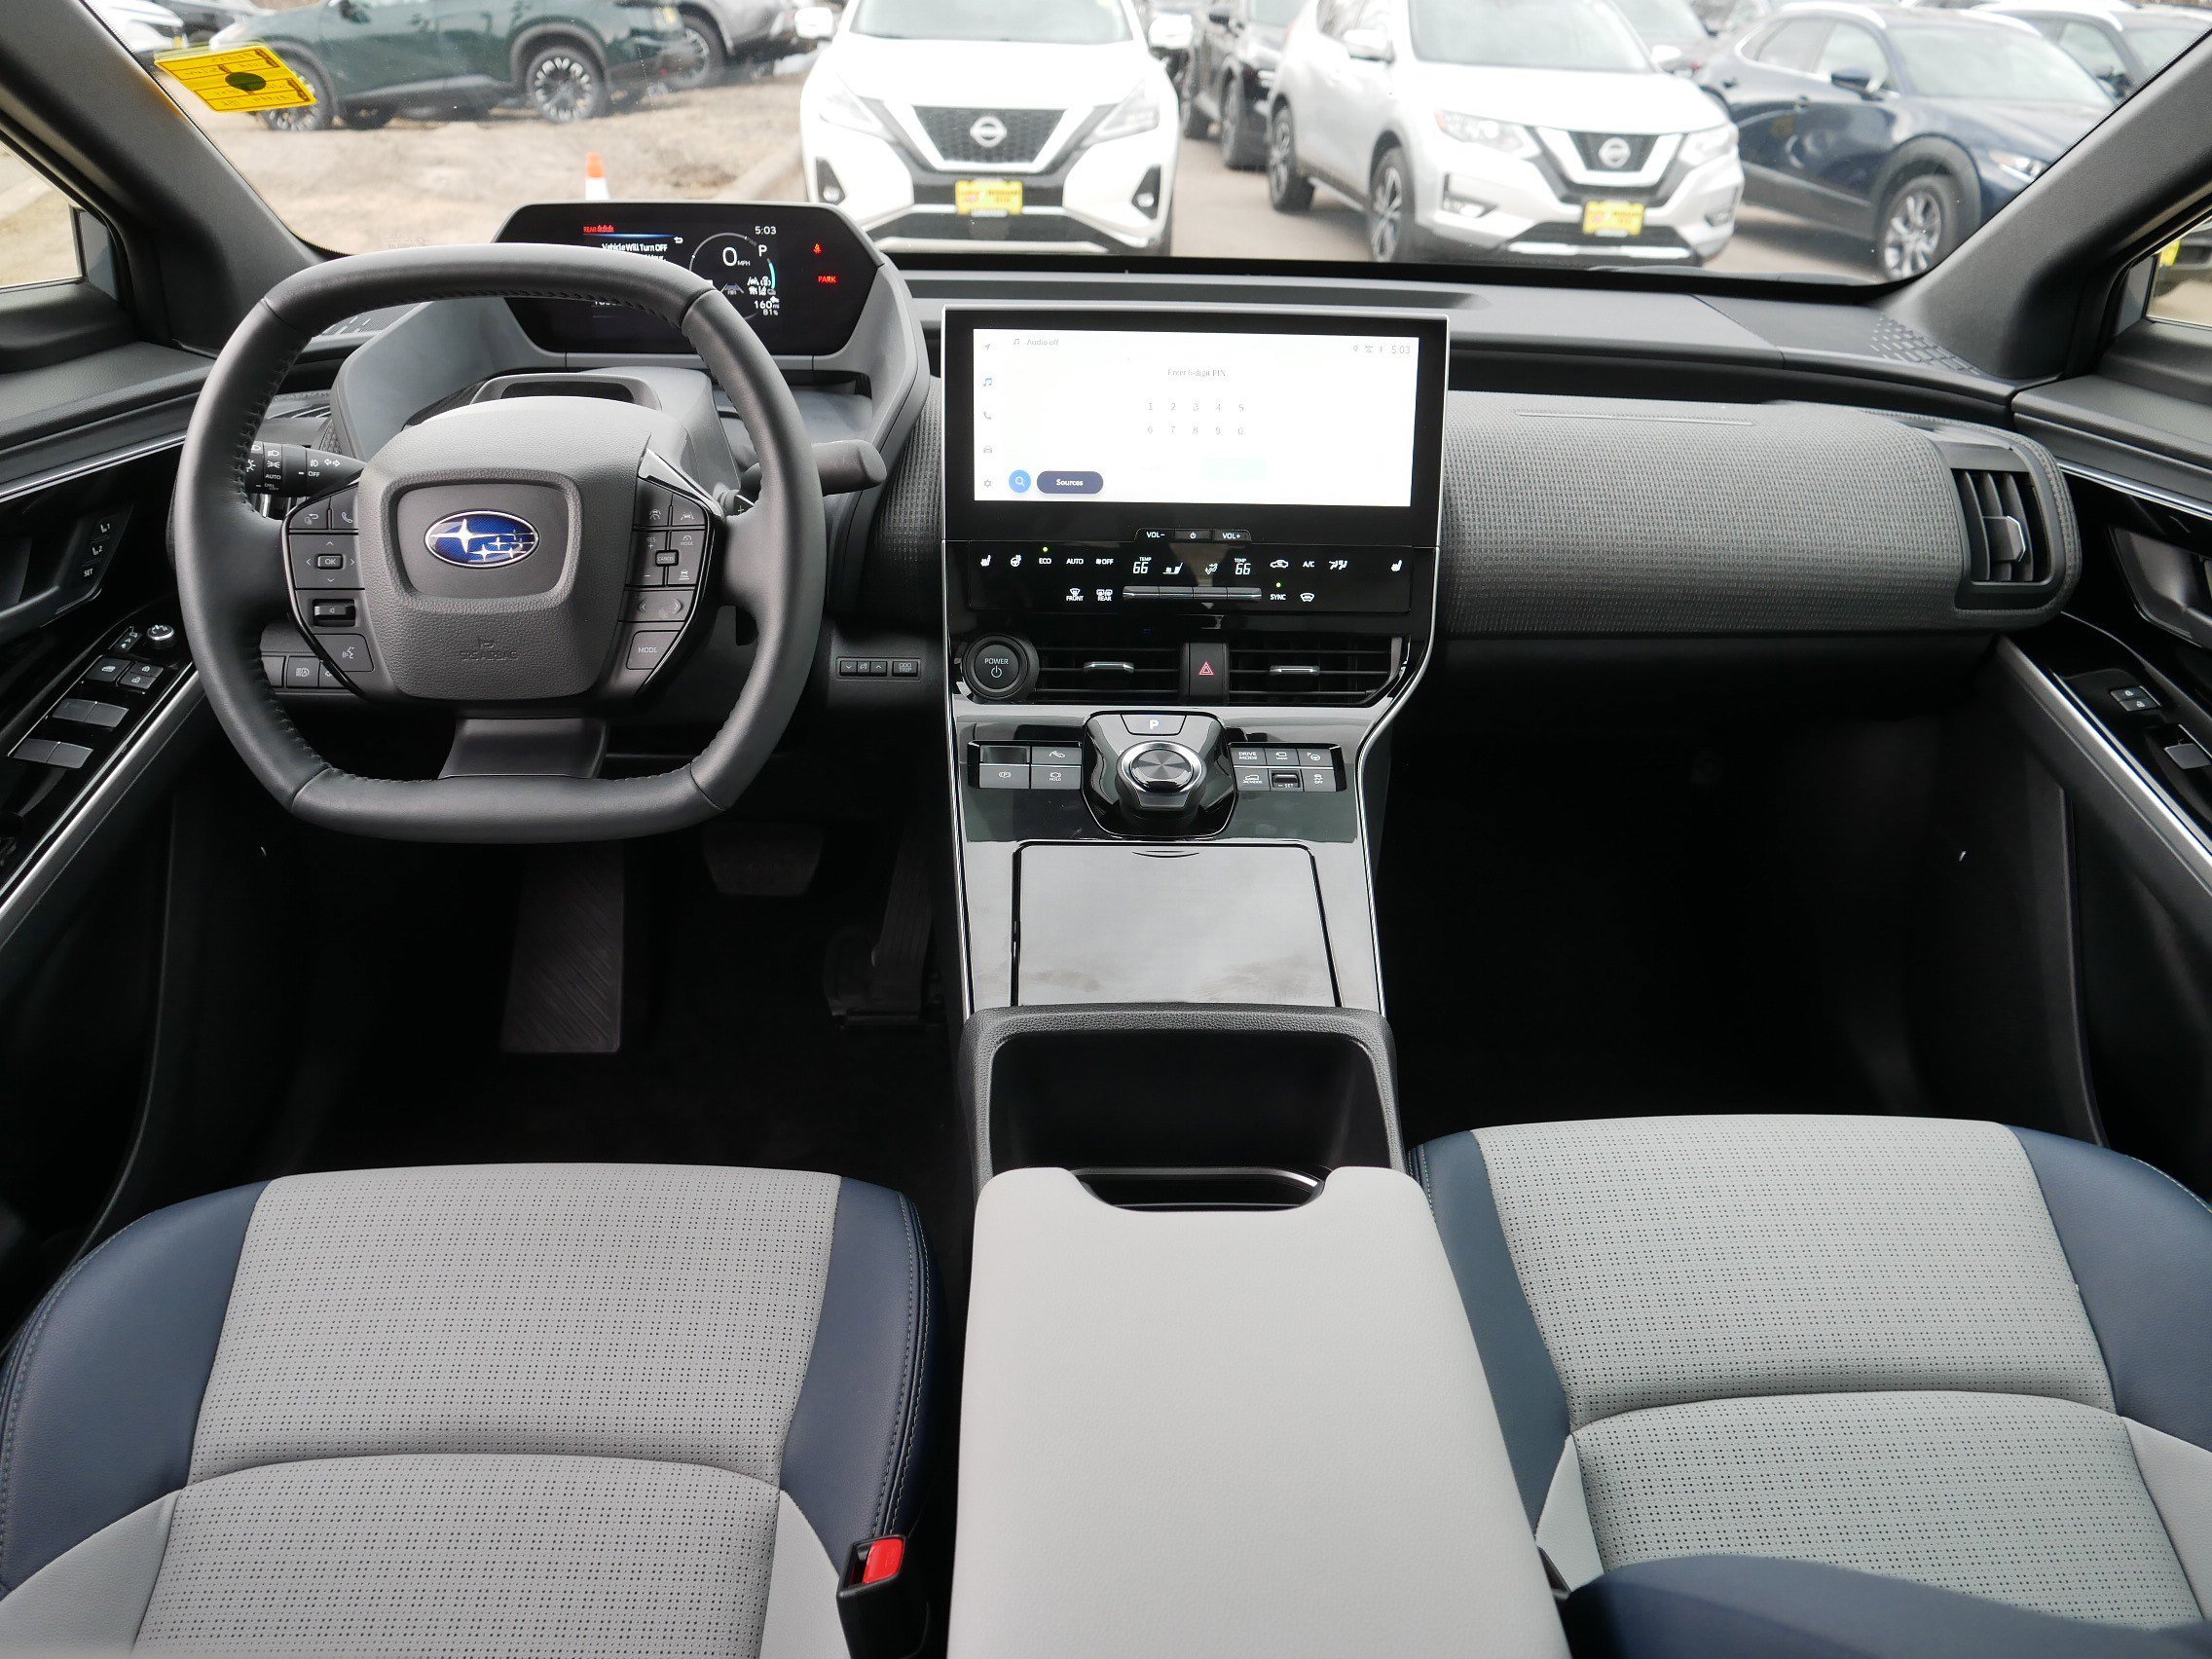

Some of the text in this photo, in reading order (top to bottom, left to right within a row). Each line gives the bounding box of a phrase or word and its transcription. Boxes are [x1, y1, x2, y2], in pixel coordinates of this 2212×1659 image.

[756, 226, 776, 235] 5:03
[602, 242, 668, 252] Vehicle Will Turn OFF
[757, 244, 767, 257] P
[722, 246, 737, 267] 0
[1055, 478, 1084, 487] Sources
[1132, 561, 1149, 574] 66
[1235, 563, 1251, 575] 66
[1149, 719, 1160, 730] P
